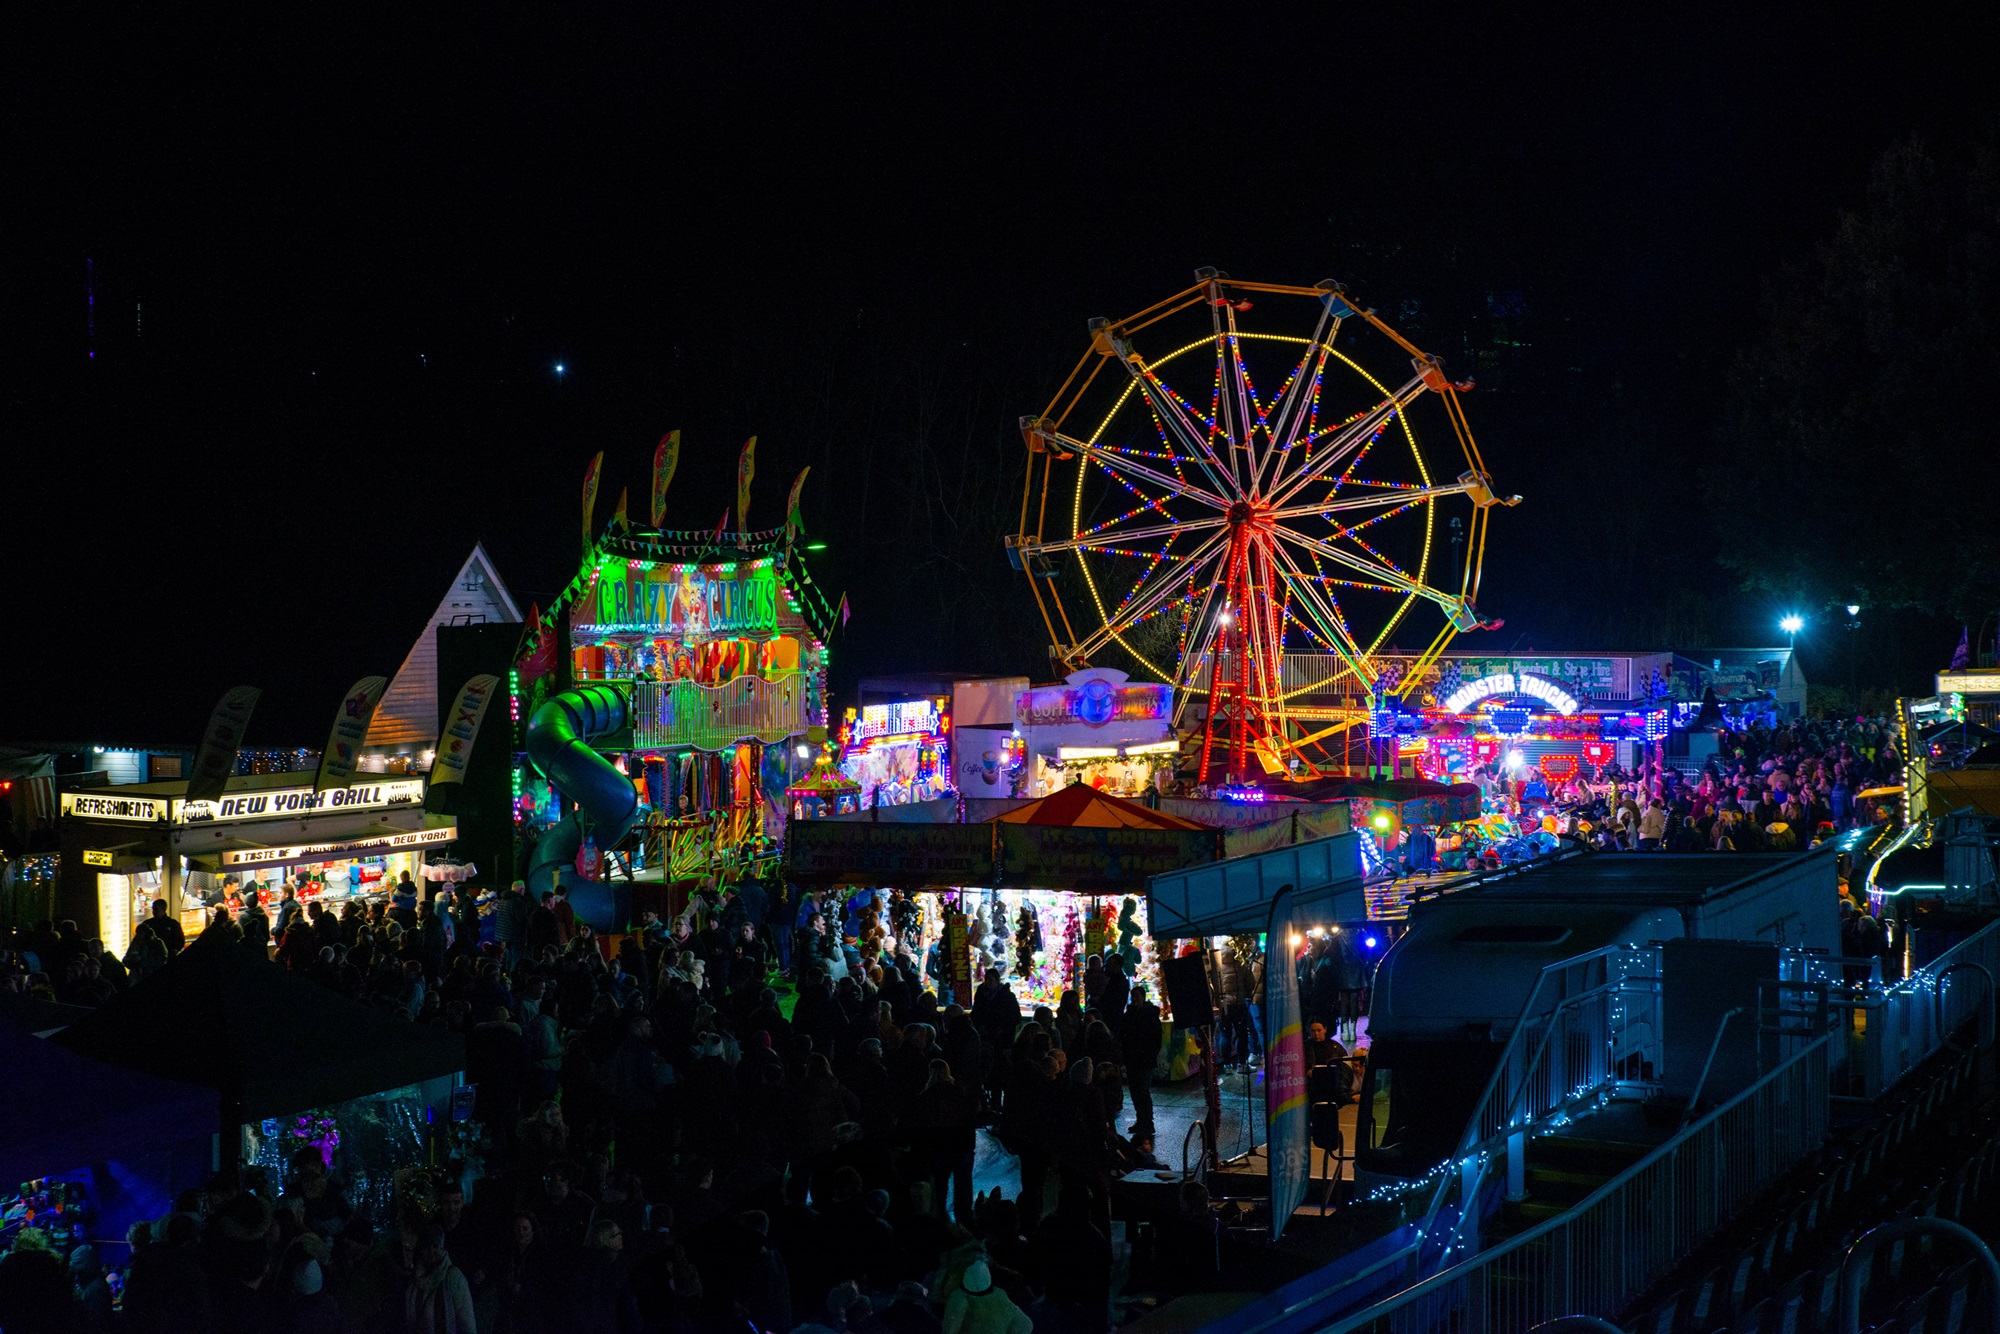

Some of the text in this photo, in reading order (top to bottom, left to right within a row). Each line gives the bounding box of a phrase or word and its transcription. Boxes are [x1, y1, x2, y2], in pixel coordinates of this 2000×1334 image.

[600, 577, 776, 633] CRAZY CIRCUS
[1486, 661, 1509, 675] Event
[1552, 661, 1561, 676] &
[1591, 661, 1611, 676] Hire
[1712, 674, 1748, 684] Snowman
[1445, 674, 1577, 716] MONSTER TRUCKS
[1033, 696, 1159, 718] COFFEE DONUTS
[962, 761, 983, 776] Coffee
[75, 797, 155, 818] REFRESHMENTS
[220, 795, 267, 817] NEW
[273, 791, 325, 811] YORK
[331, 787, 383, 807] GRILL
[394, 829, 448, 846] NEW YORK
[233, 848, 291, 863] A TASTE OF
[951, 916, 966, 926] ANY
[1086, 920, 1103, 930] ANY
[953, 927, 969, 981] PRIZE
